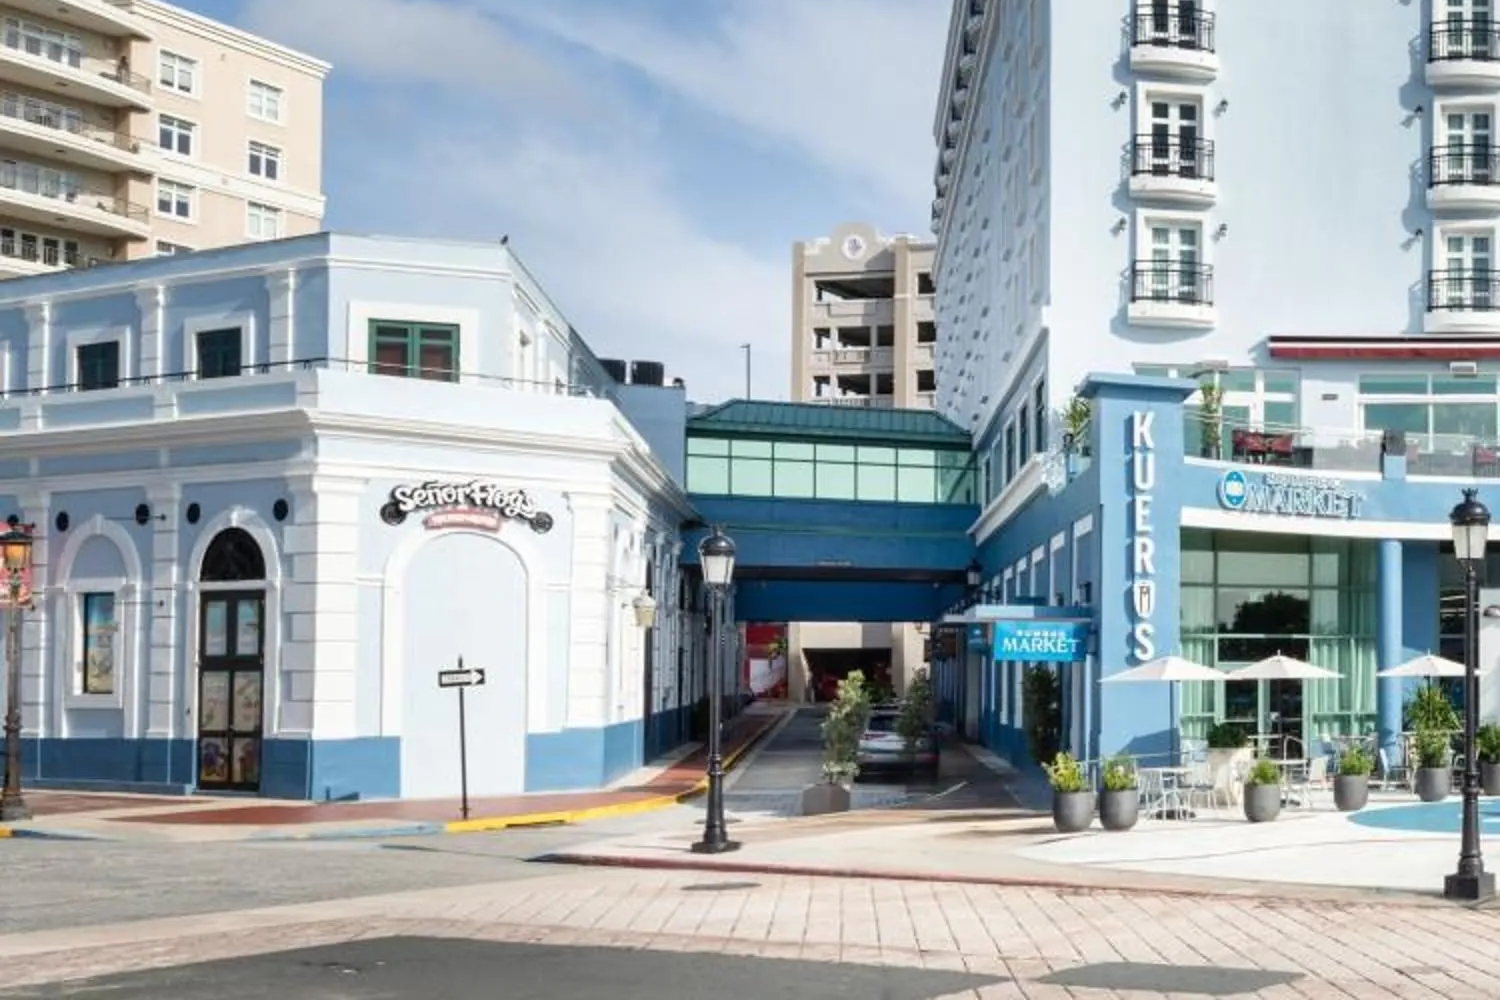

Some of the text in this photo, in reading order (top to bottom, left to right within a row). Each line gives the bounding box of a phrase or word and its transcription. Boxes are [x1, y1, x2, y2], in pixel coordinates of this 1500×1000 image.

[1246, 484, 1364, 518] MARKET
[1133, 411, 1155, 661] KUEROS
[1003, 638, 1081, 653] MARKET
